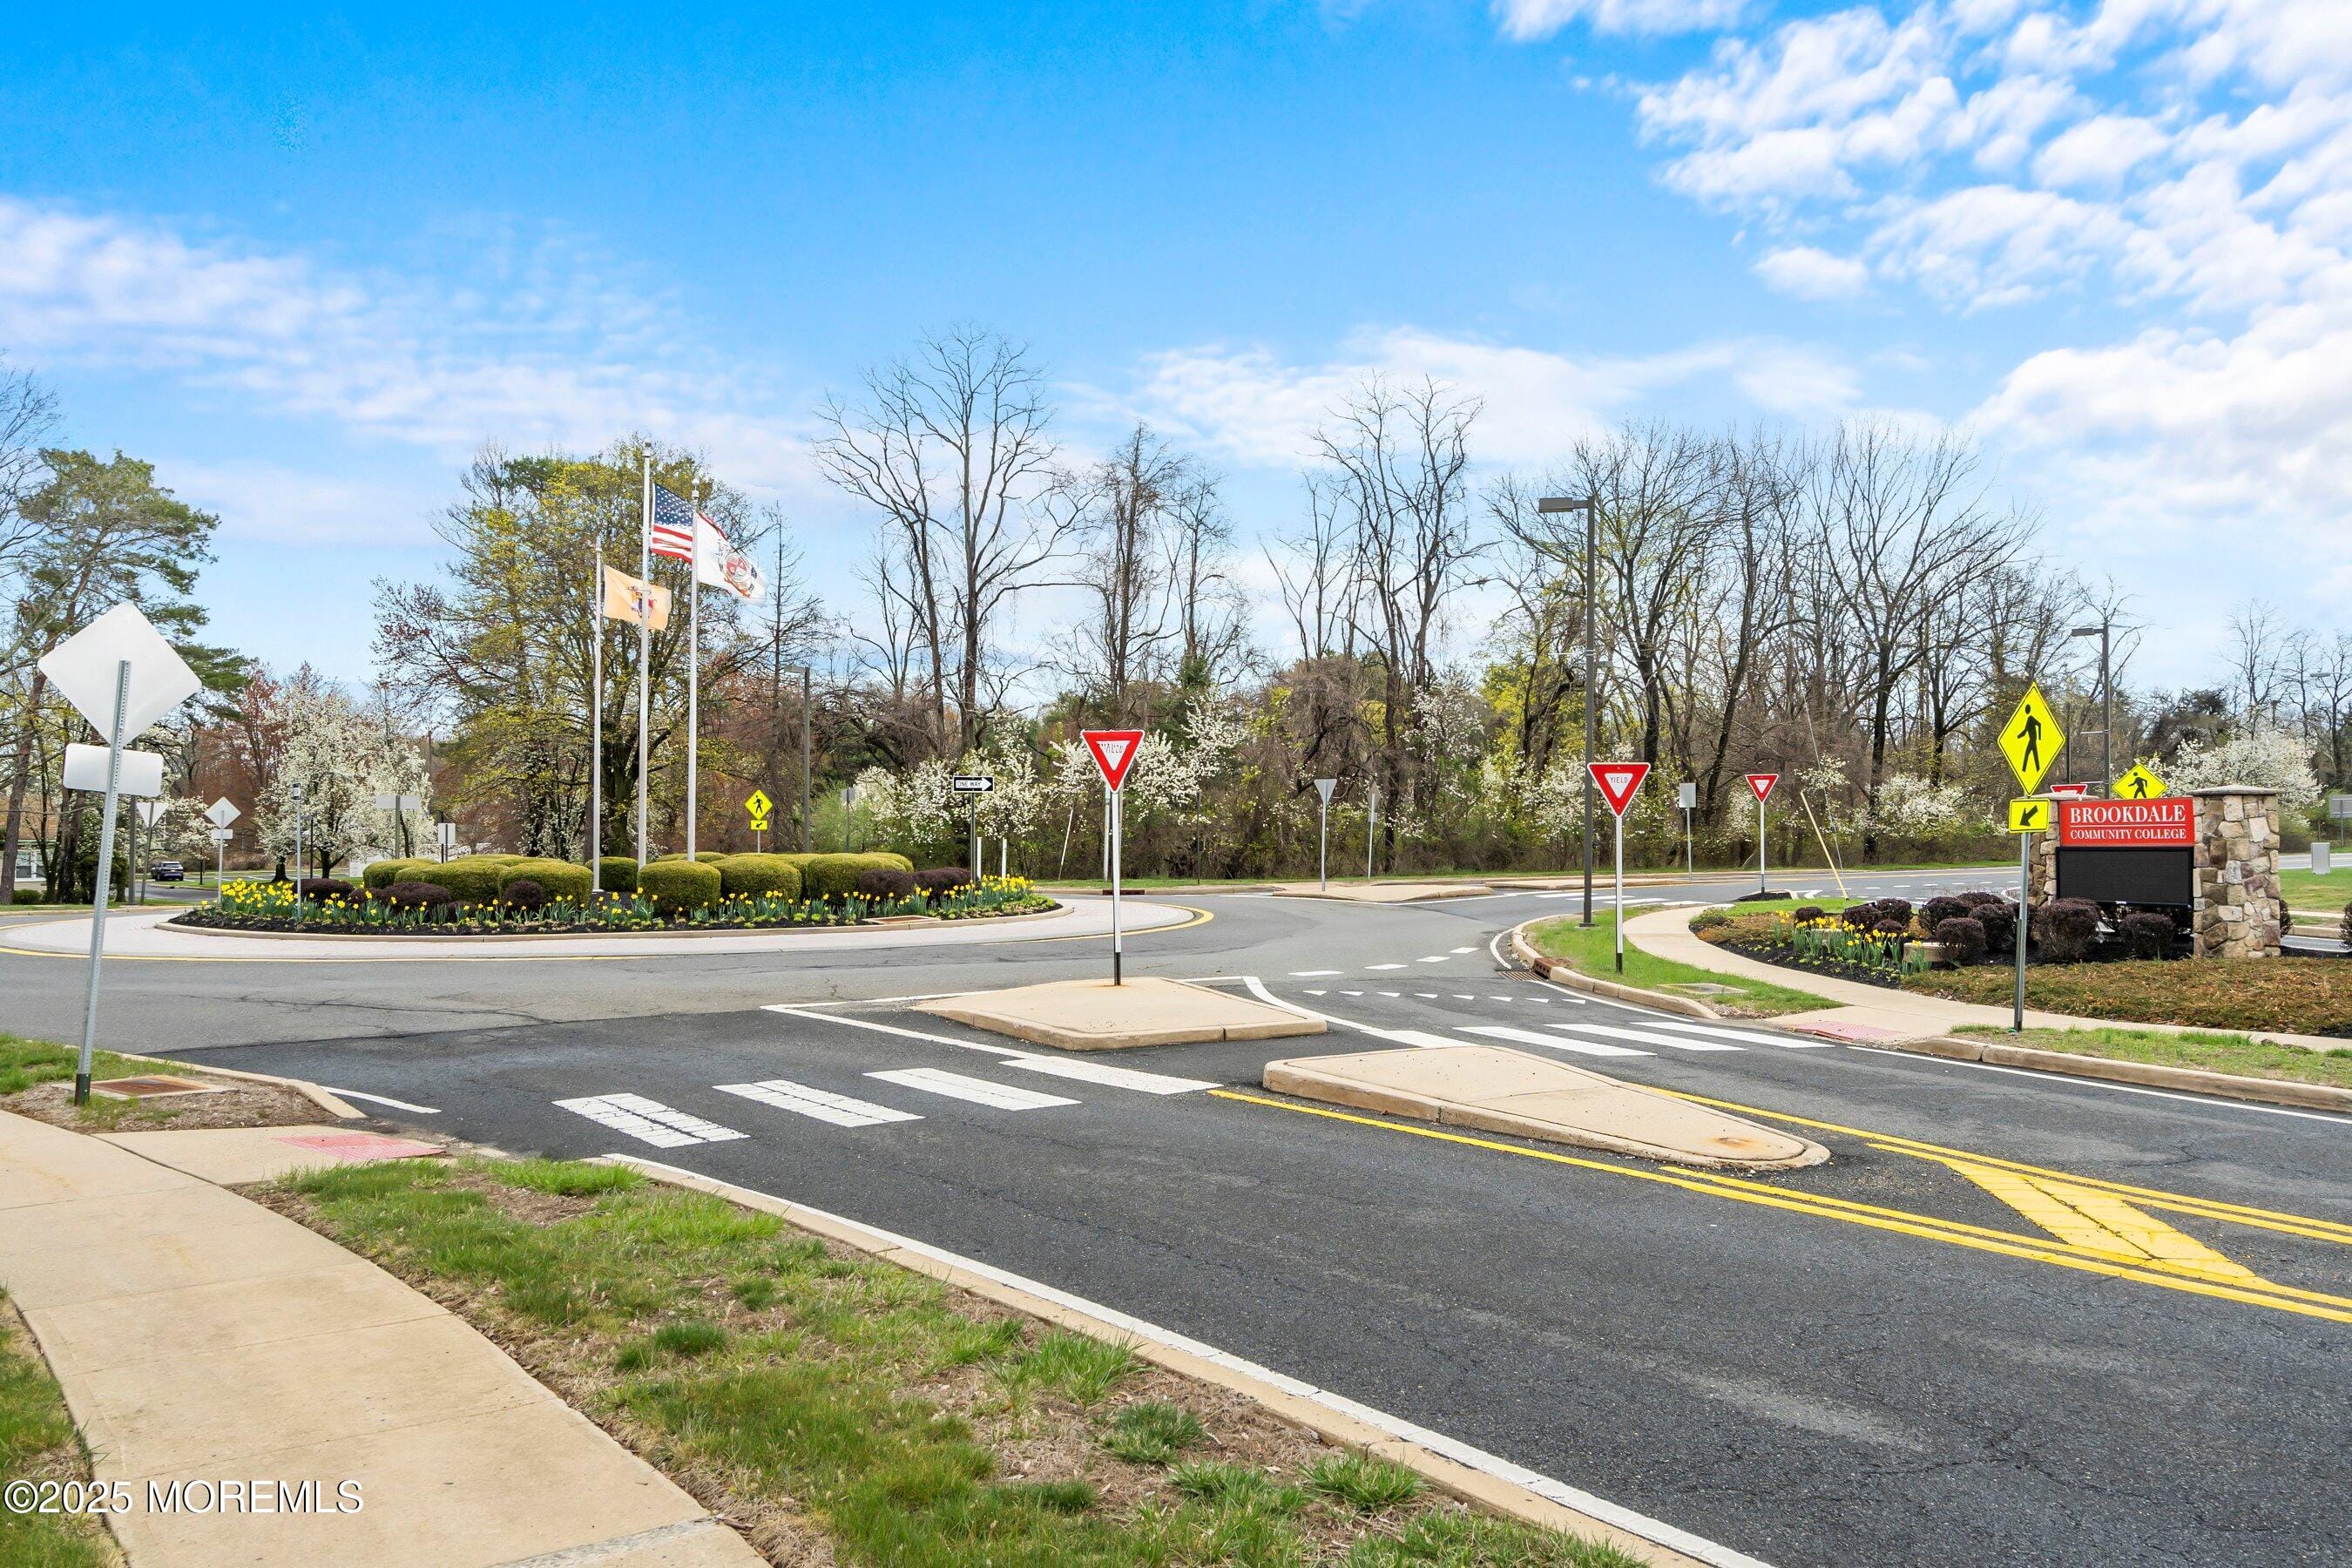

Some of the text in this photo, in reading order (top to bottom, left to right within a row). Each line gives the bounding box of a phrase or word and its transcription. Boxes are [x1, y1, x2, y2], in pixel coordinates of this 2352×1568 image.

[2070, 804, 2186, 823] BROOKDALE
[2070, 828, 2186, 840] COMMUNITY COLLEGE
